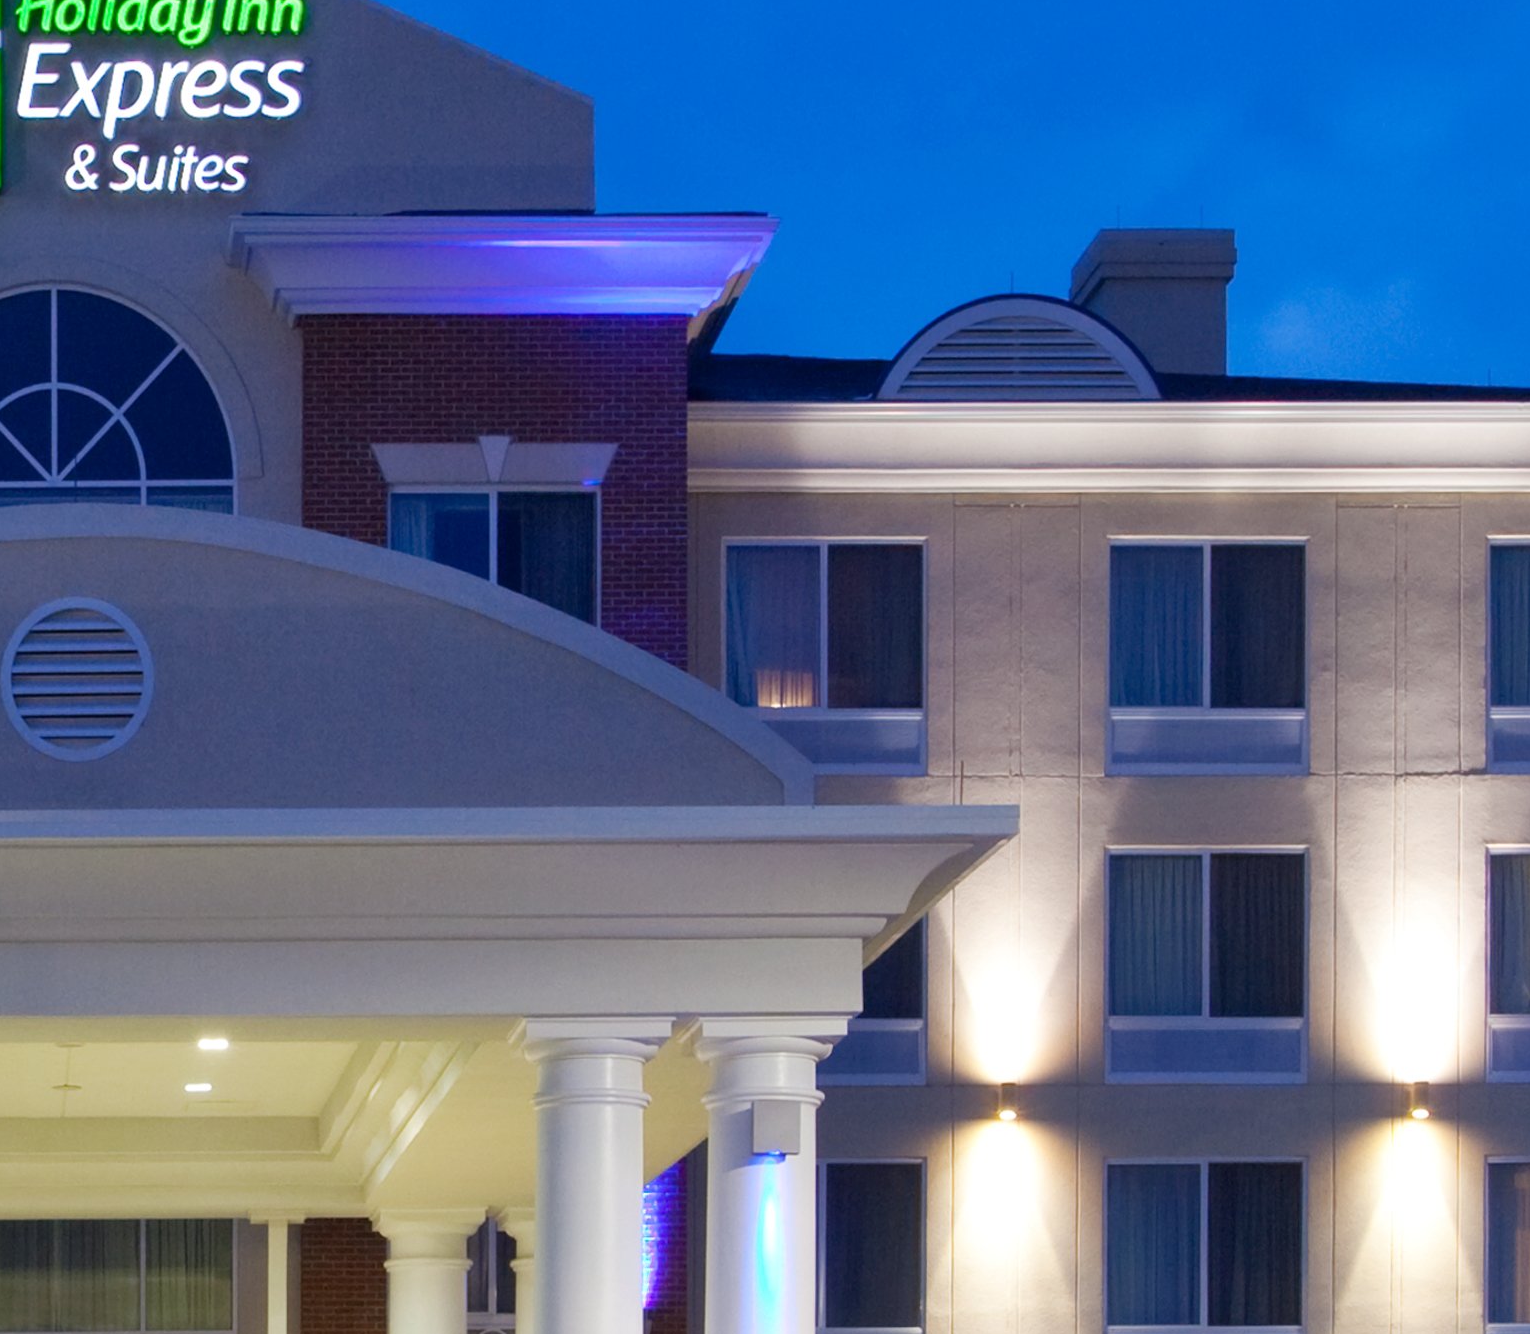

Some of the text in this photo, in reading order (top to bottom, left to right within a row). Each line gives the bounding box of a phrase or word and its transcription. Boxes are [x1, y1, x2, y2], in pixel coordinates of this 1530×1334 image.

[15, 42, 306, 140] Express
[64, 143, 249, 193] & Suites
